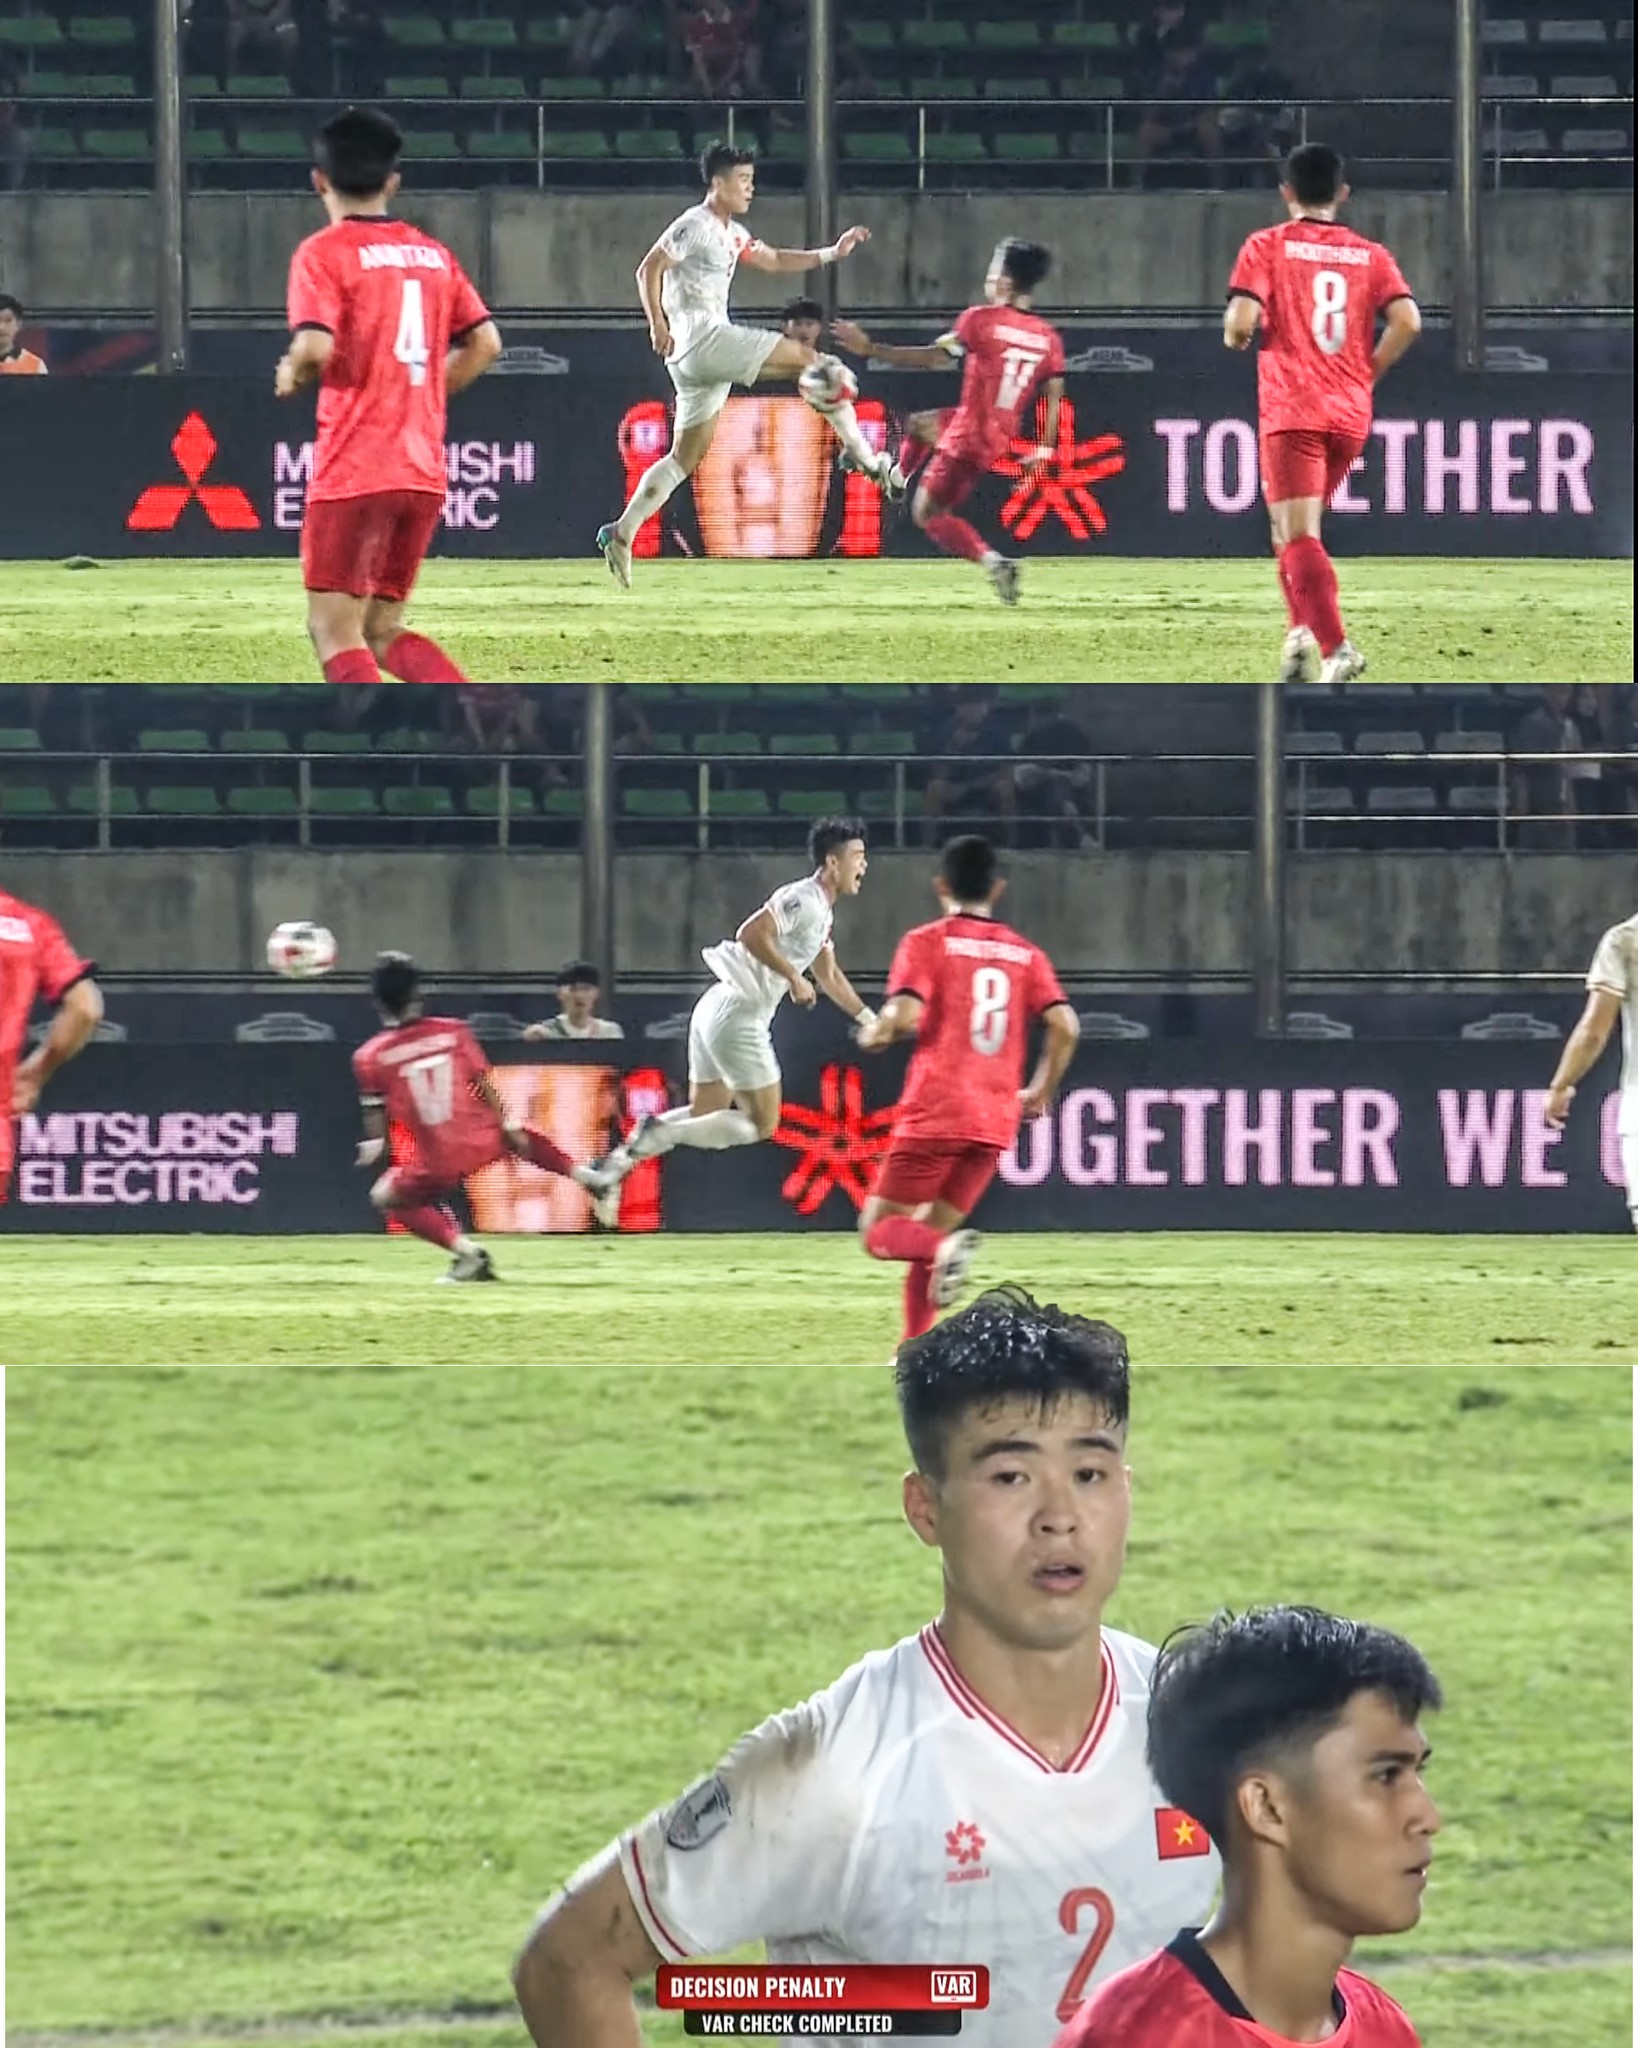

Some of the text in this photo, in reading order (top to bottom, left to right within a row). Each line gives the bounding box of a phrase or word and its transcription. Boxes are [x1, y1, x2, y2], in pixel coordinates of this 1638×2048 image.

[393, 278, 431, 386] 4
[1311, 269, 1348, 355] 8
[995, 347, 1046, 411] 17
[1155, 417, 1595, 514] TOETHER
[969, 966, 1011, 1056] 8
[19, 1112, 298, 1154] MITSUBISHI
[398, 1052, 454, 1126] 17
[997, 1087, 1401, 1187] OGETHER
[1437, 1088, 1568, 1187] WE
[19, 1160, 260, 1203] ELECTRIC
[1056, 1887, 1114, 2024] 2
